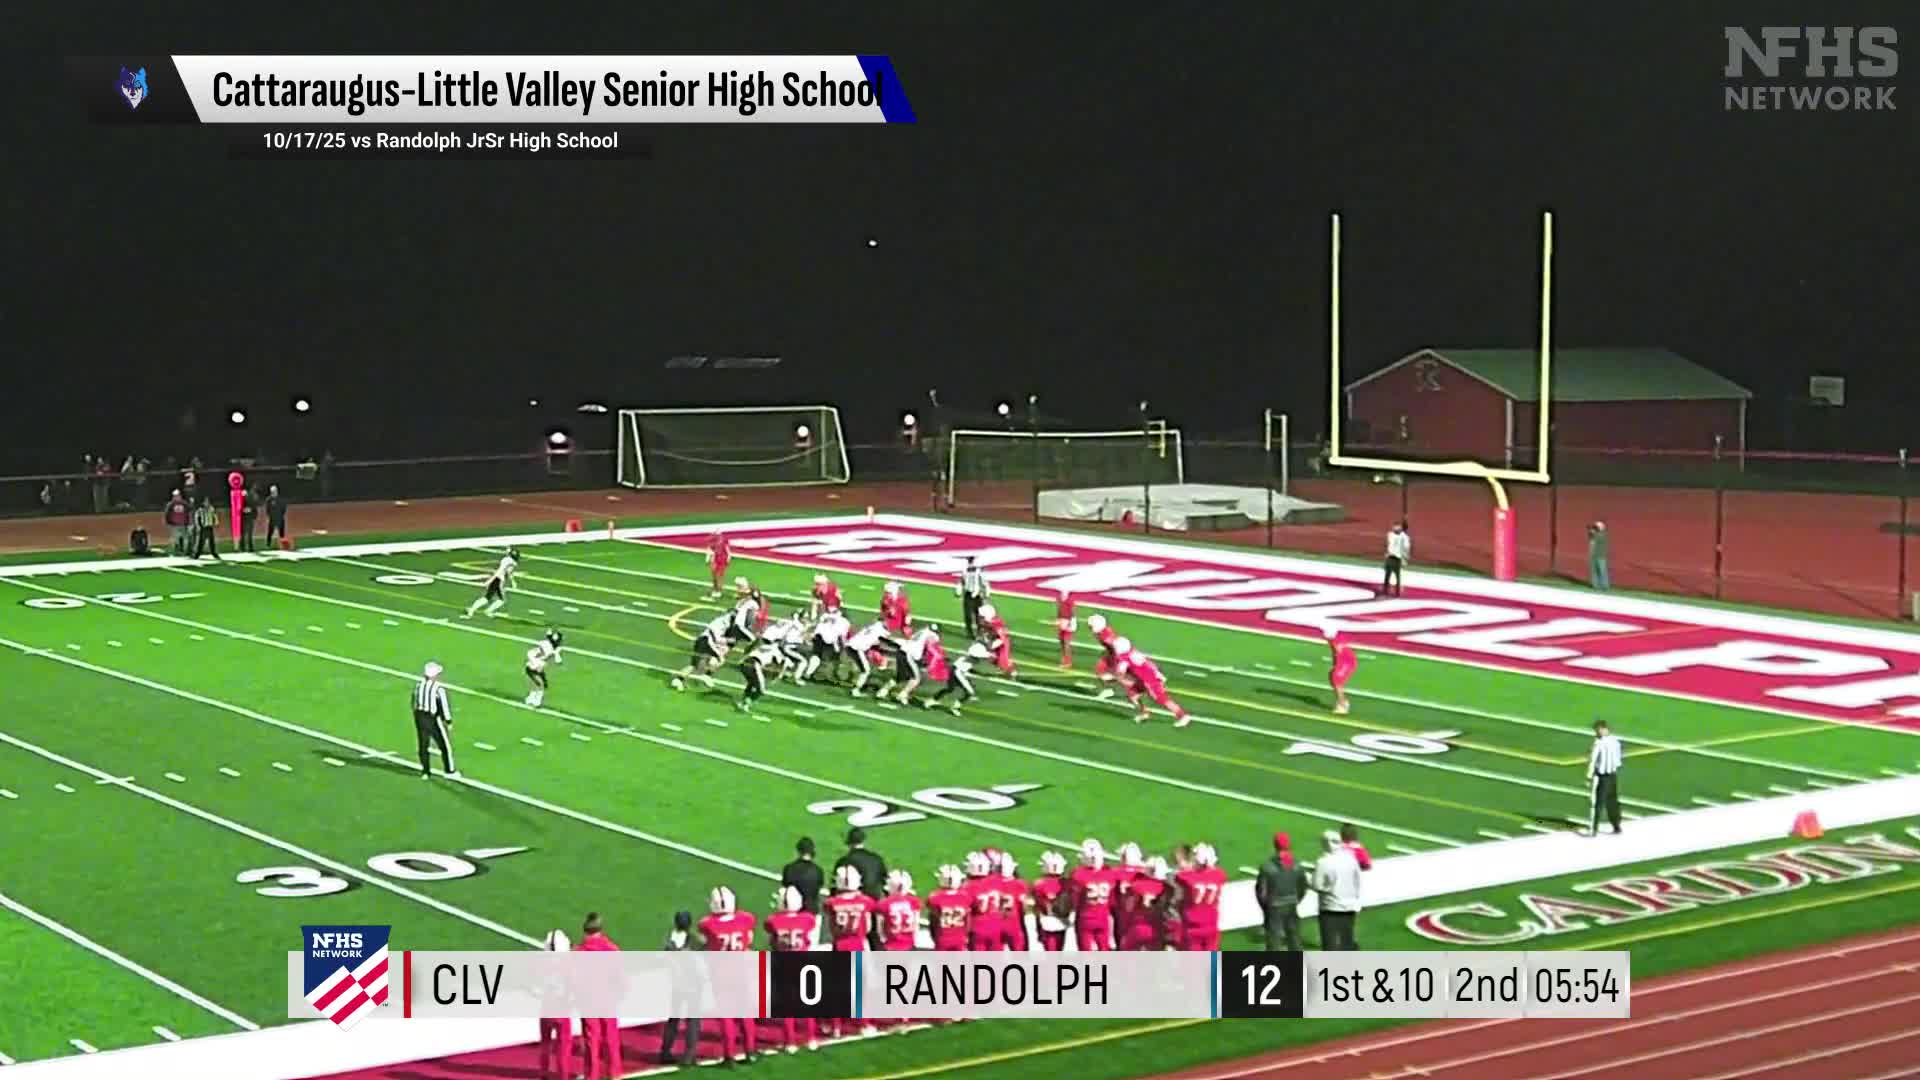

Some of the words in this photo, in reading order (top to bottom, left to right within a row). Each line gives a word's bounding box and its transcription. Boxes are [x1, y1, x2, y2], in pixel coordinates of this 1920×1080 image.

[1281, 733, 1450, 763] 10
[805, 786, 1017, 828] 20
[235, 851, 477, 898] 30
[1404, 828, 1920, 946] CARDIN
[834, 911, 862, 930] 97
